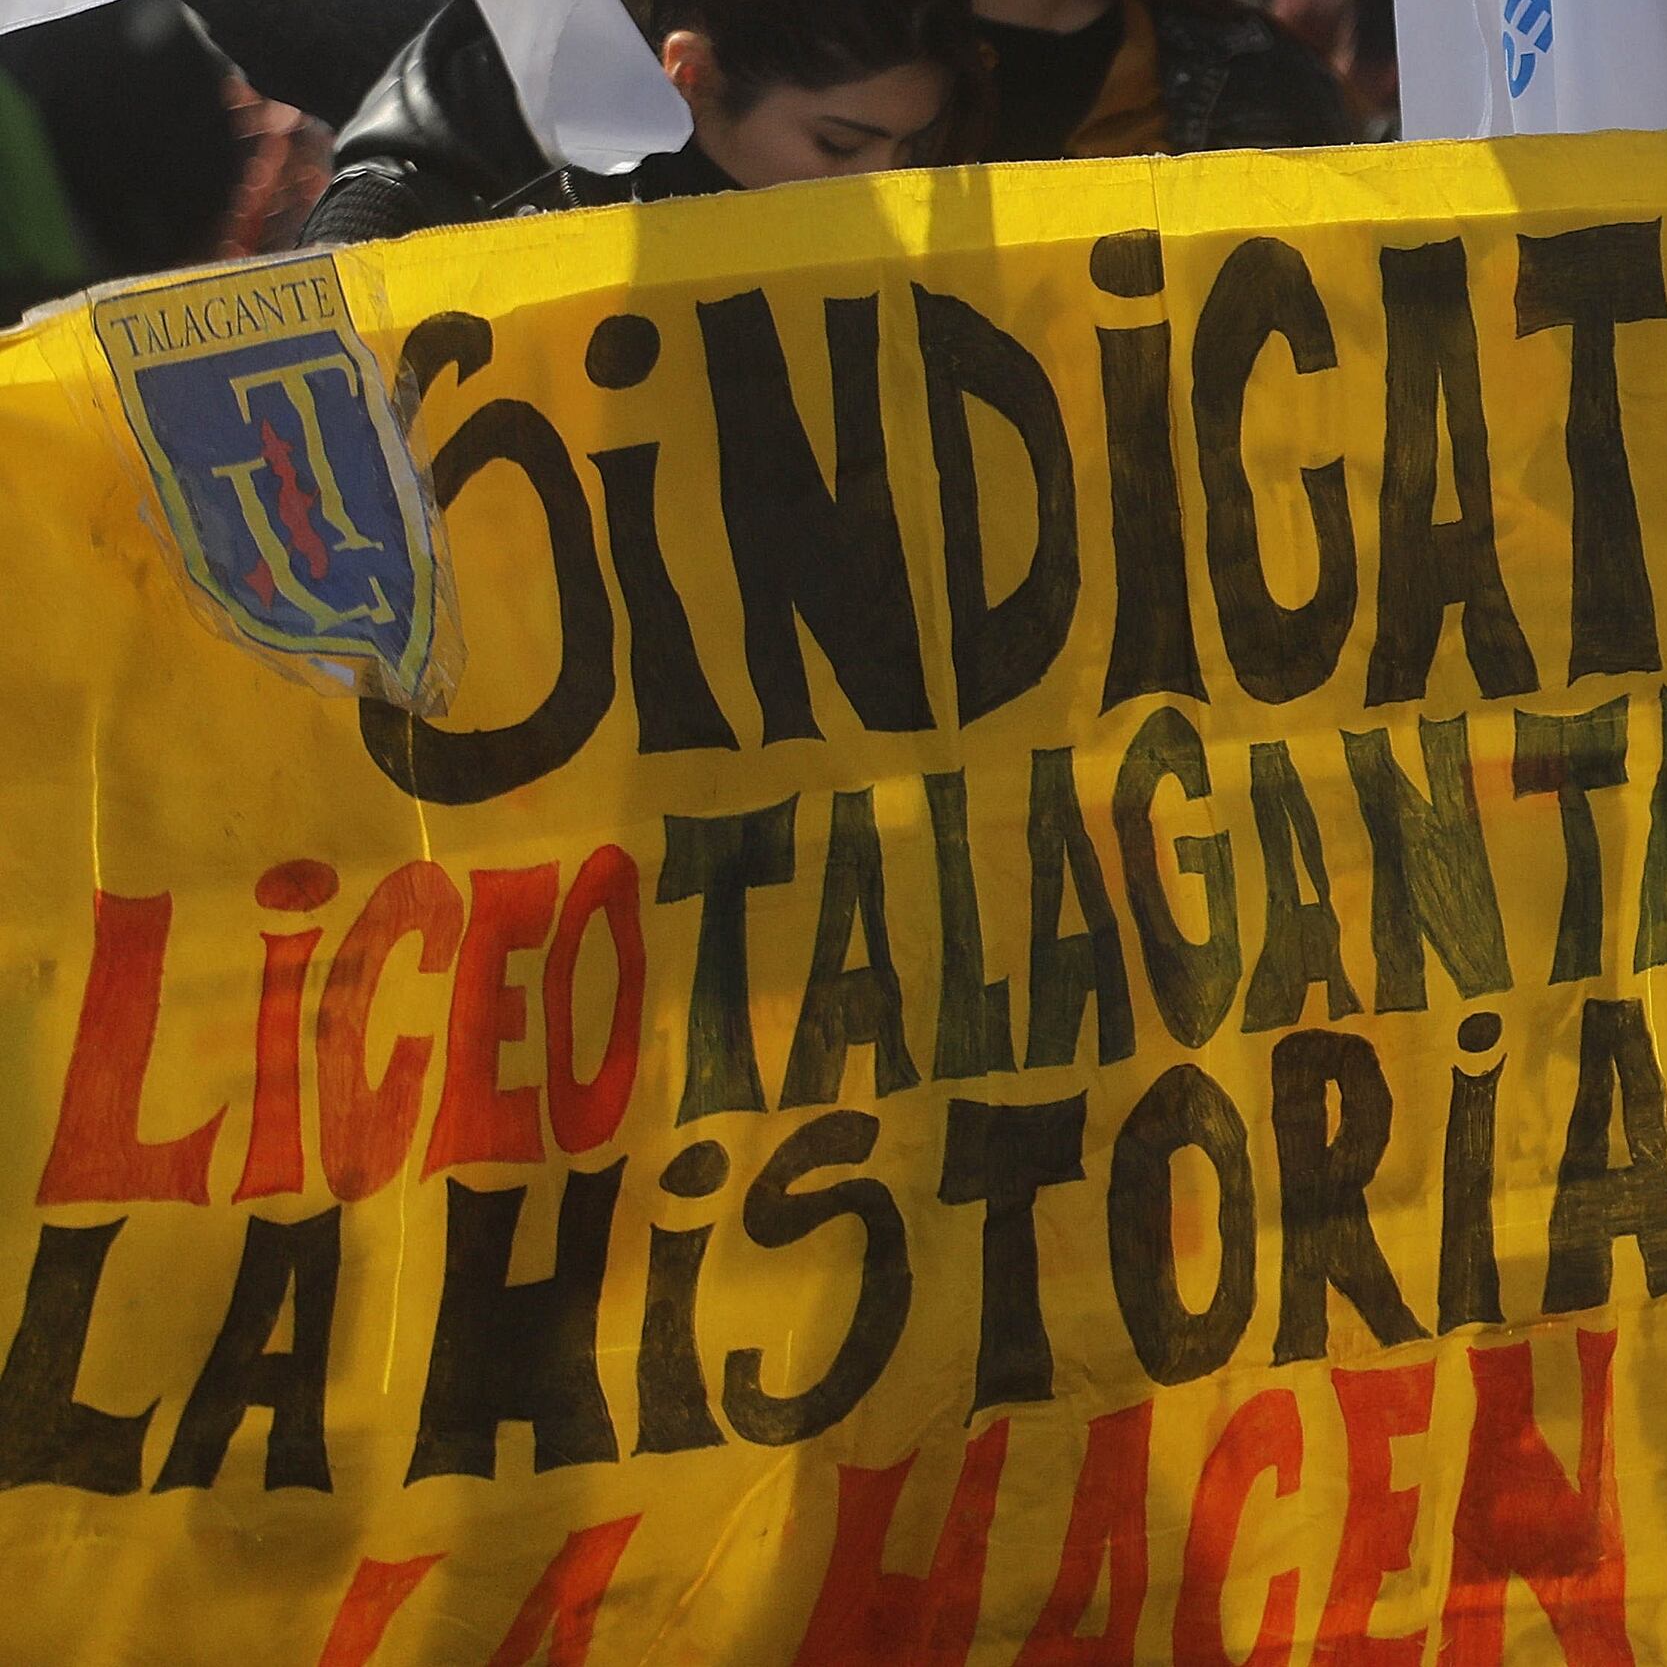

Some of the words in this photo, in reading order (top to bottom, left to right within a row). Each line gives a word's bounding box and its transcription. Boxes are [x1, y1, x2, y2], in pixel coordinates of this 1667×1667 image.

[109, 277, 337, 358] TALAGANTE
[0, 1205, 342, 1495] LA
[792, 1329, 1637, 1667] HACEN
